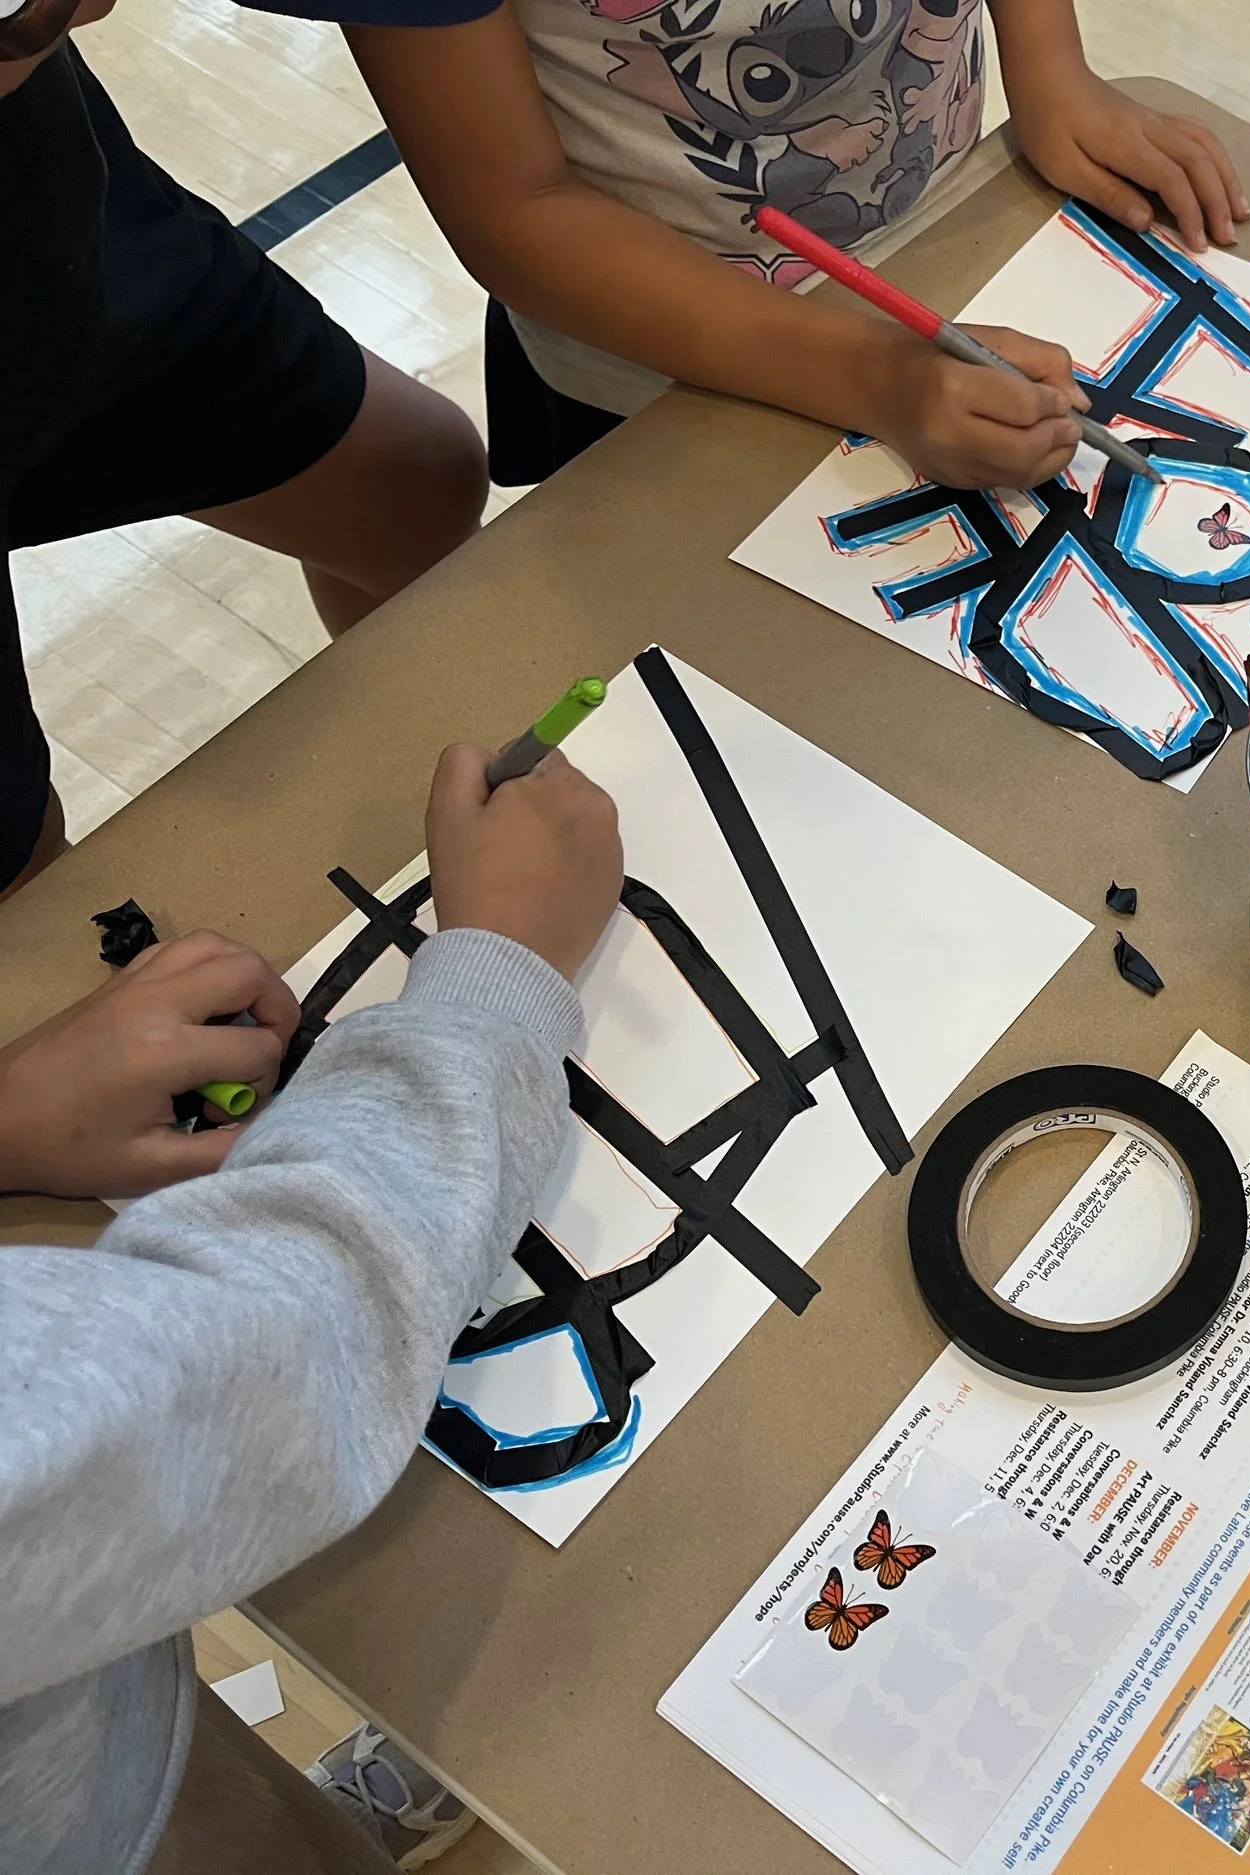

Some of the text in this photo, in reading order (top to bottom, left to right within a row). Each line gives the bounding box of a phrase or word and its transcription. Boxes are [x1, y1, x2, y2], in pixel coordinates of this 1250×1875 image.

[1005, 1139, 1141, 1304] olumbia Pike, Arlington 22204 (next to Good
[1038, 1147, 1147, 1281] St N, Arlington 22203 (second floor)
[1189, 1320, 1222, 1360] Columbia
[1175, 1358, 1196, 1379] Pike
[1202, 1375, 1219, 1392] pm,
[1175, 1394, 1208, 1434] Columbia
[1161, 1433, 1181, 1454] Pike
[1197, 1418, 1232, 1460] Sánchez
[1085, 1458, 1138, 1524] DECEMBER:
[1135, 1470, 1153, 1489] Art
[754, 1404, 931, 1622] More at www.StudioPause.com/projects/hope
[1112, 1487, 1142, 1524] PAUSE
[1133, 1483, 1171, 1525] Thursday,
[1096, 1522, 1116, 1544] with
[1110, 1490, 1182, 1586] Resistance through
[1118, 1525, 1140, 1547] Nov.
[1147, 1501, 1199, 1569] NOVEMBER:
[1218, 1511, 1246, 1543] Latino
[1082, 1544, 1102, 1566] Dav
[1105, 1548, 1124, 1565] 20,
[1218, 1538, 1244, 1573] events
[1181, 1542, 1222, 1599] community
[1208, 1571, 1222, 1587] as
[1193, 1585, 1212, 1611] part
[1148, 1597, 1186, 1647] members
[1173, 1622, 1189, 1642] our
[1185, 1609, 1197, 1625] of
[1134, 1646, 1152, 1671] and
[1147, 1641, 1176, 1678] exhibit
[1113, 1668, 1138, 1699] make
[1139, 1676, 1152, 1691] at
[1096, 1699, 1120, 1725] time
[1116, 1690, 1146, 1725] Studio
[1085, 1724, 1103, 1743] for
[1090, 1724, 1123, 1766] PAUSE
[1067, 1740, 1089, 1770] your
[1049, 1769, 1070, 1795] own
[1079, 1763, 1094, 1781] on
[1018, 1794, 1053, 1841] creative
[1043, 1781, 1085, 1834] Columbia
[1000, 1841, 1022, 1869] self!
[1023, 1833, 1050, 1861] Pike.
